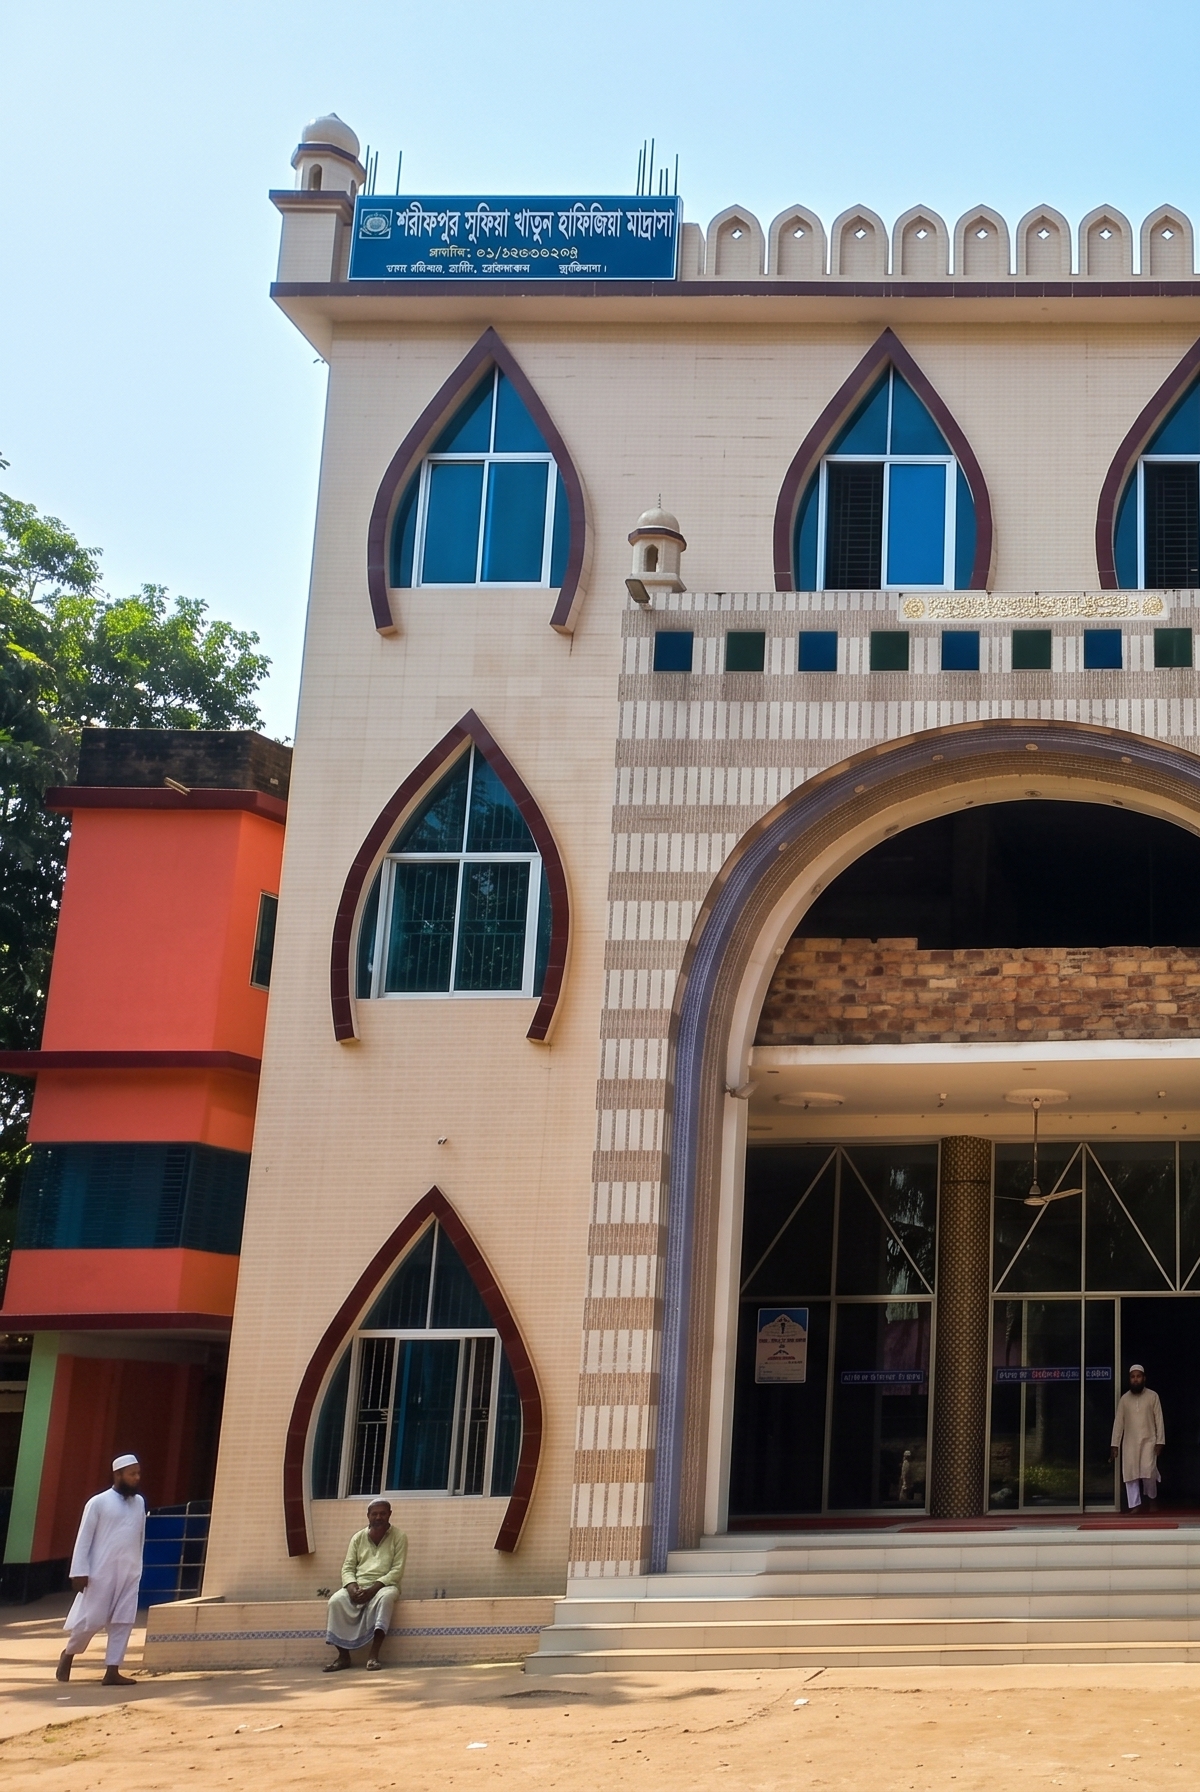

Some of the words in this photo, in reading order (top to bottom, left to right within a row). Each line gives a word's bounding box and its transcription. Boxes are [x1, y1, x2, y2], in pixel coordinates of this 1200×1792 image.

[395, 201, 461, 244] শরীফপুর
[513, 208, 555, 245] খাতুন
[625, 207, 675, 240] মাদ্রাসা
